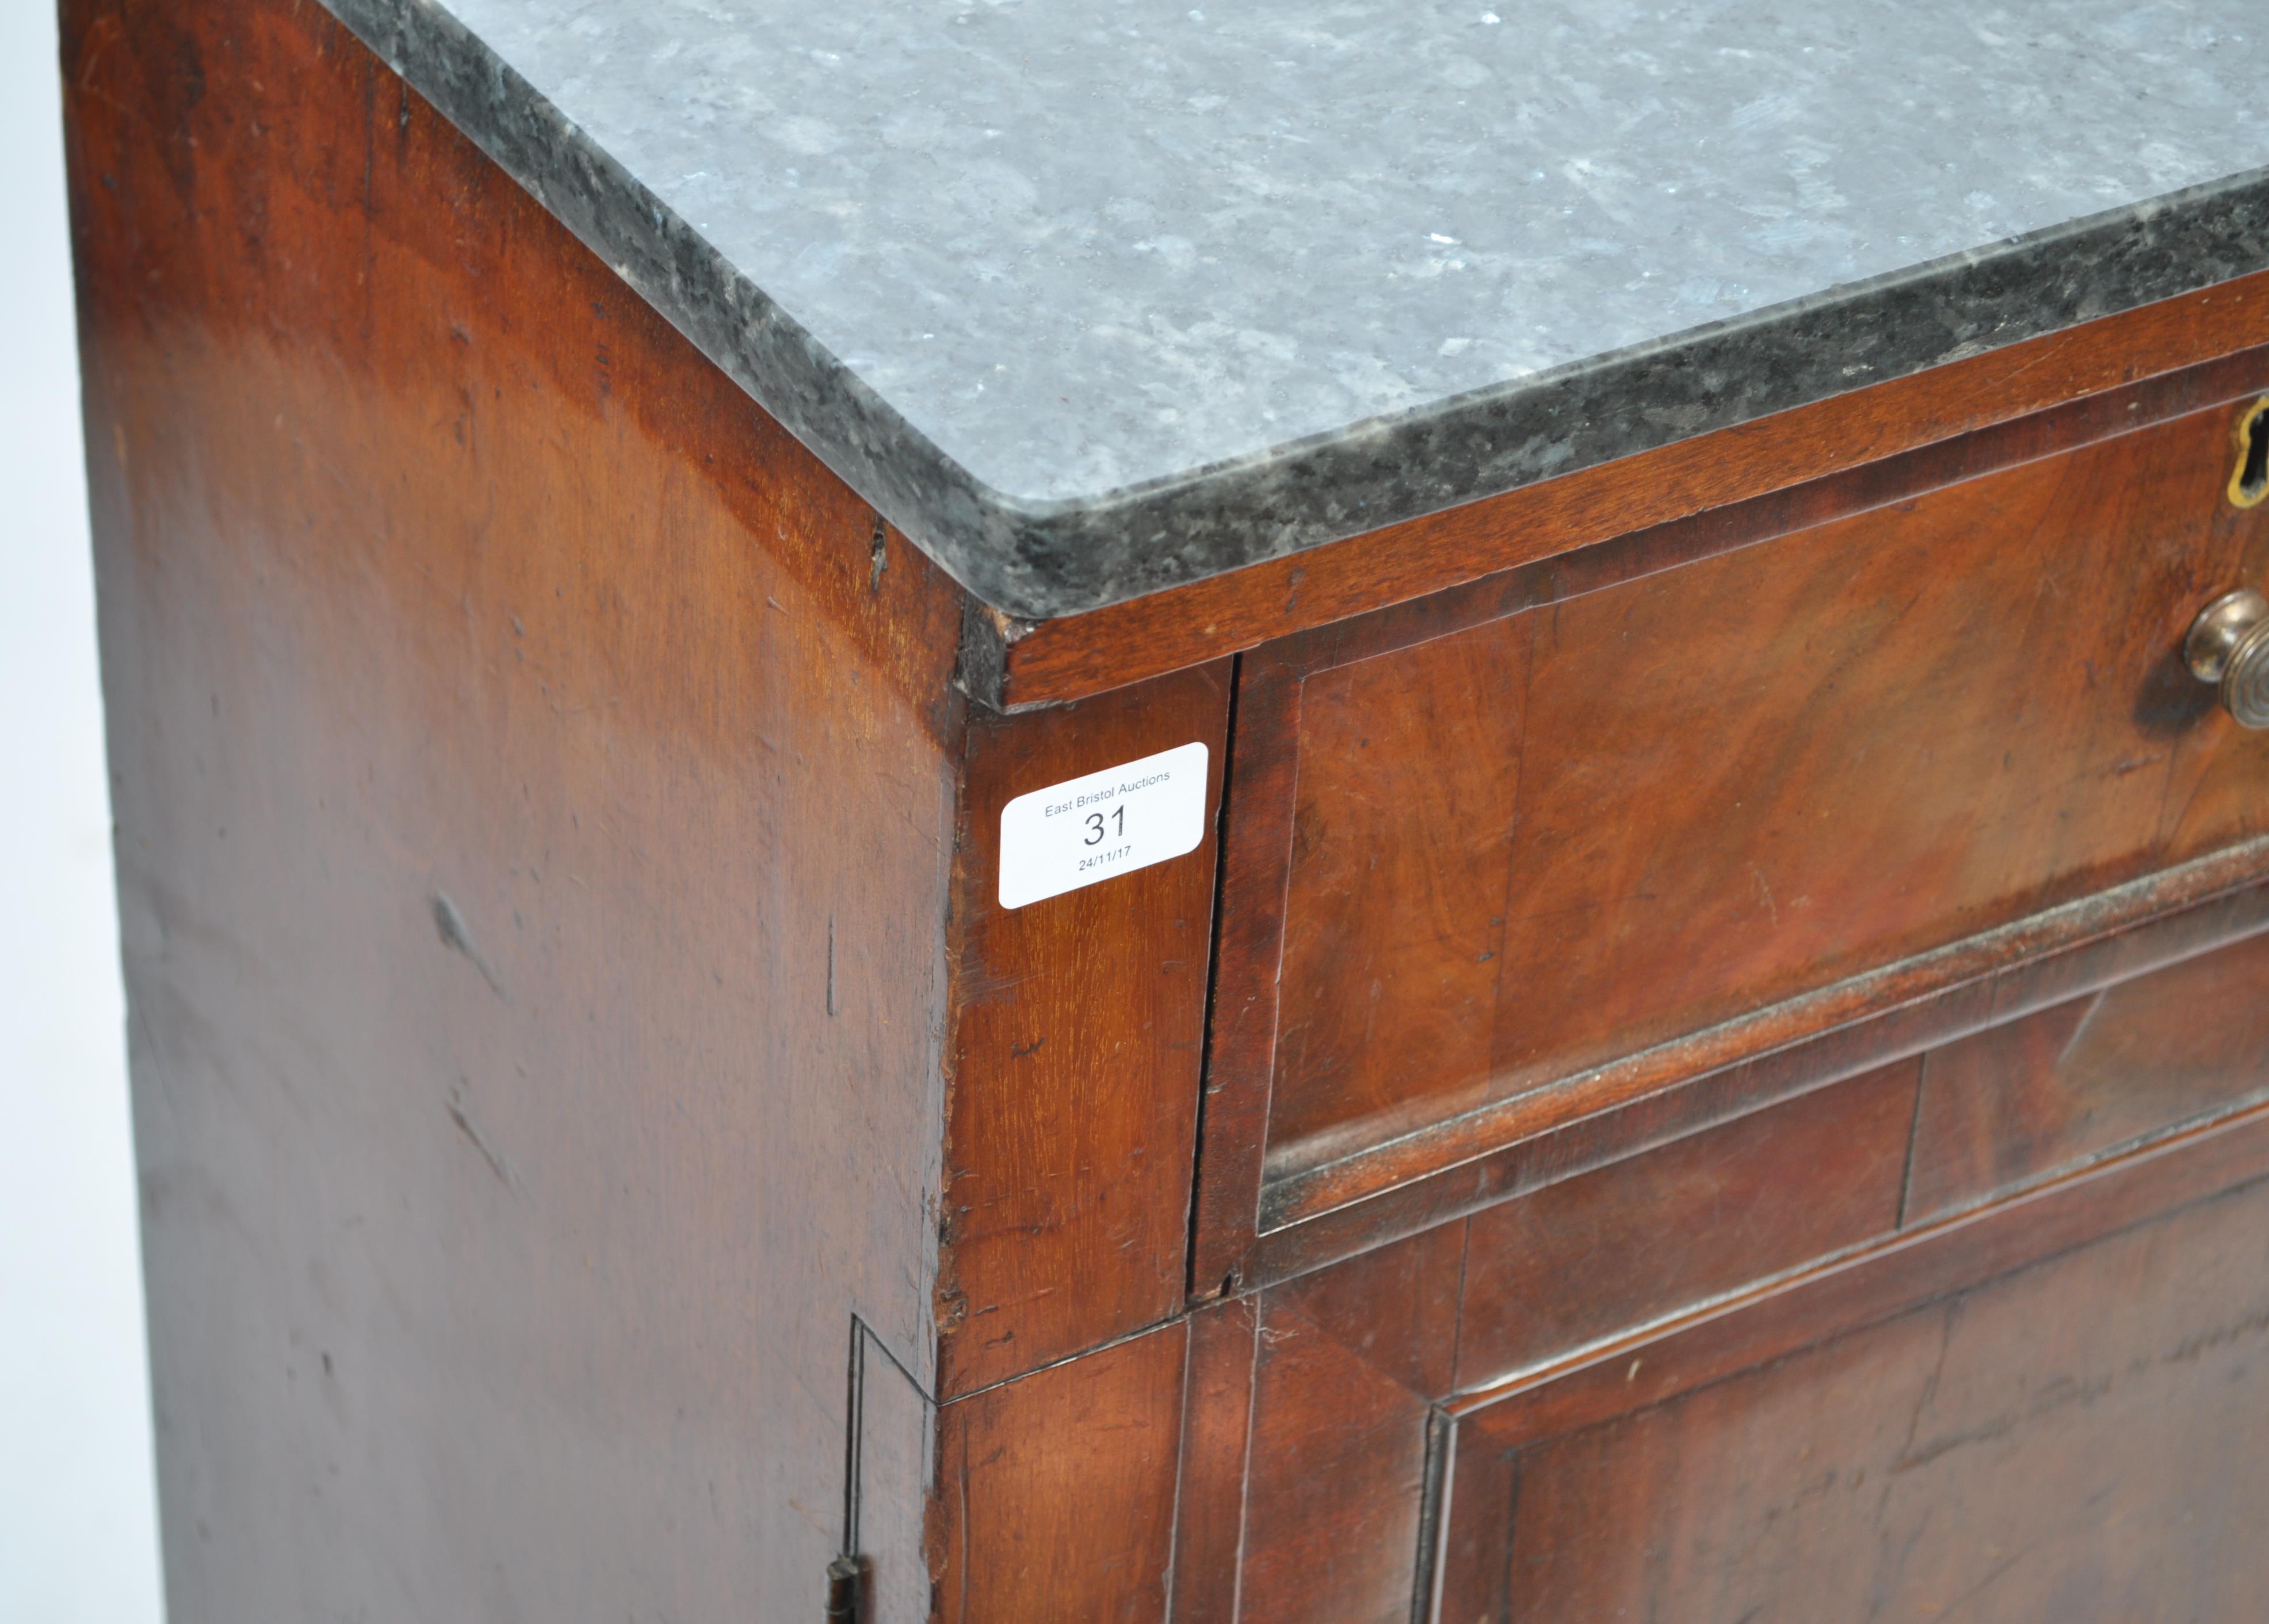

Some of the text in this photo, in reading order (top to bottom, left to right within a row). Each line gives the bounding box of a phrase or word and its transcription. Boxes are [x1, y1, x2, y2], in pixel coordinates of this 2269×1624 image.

[1045, 772, 1170, 817] East Bristol Auctions
[1084, 804, 1124, 846] 31
[1079, 845, 1131, 871] 24/11/17
